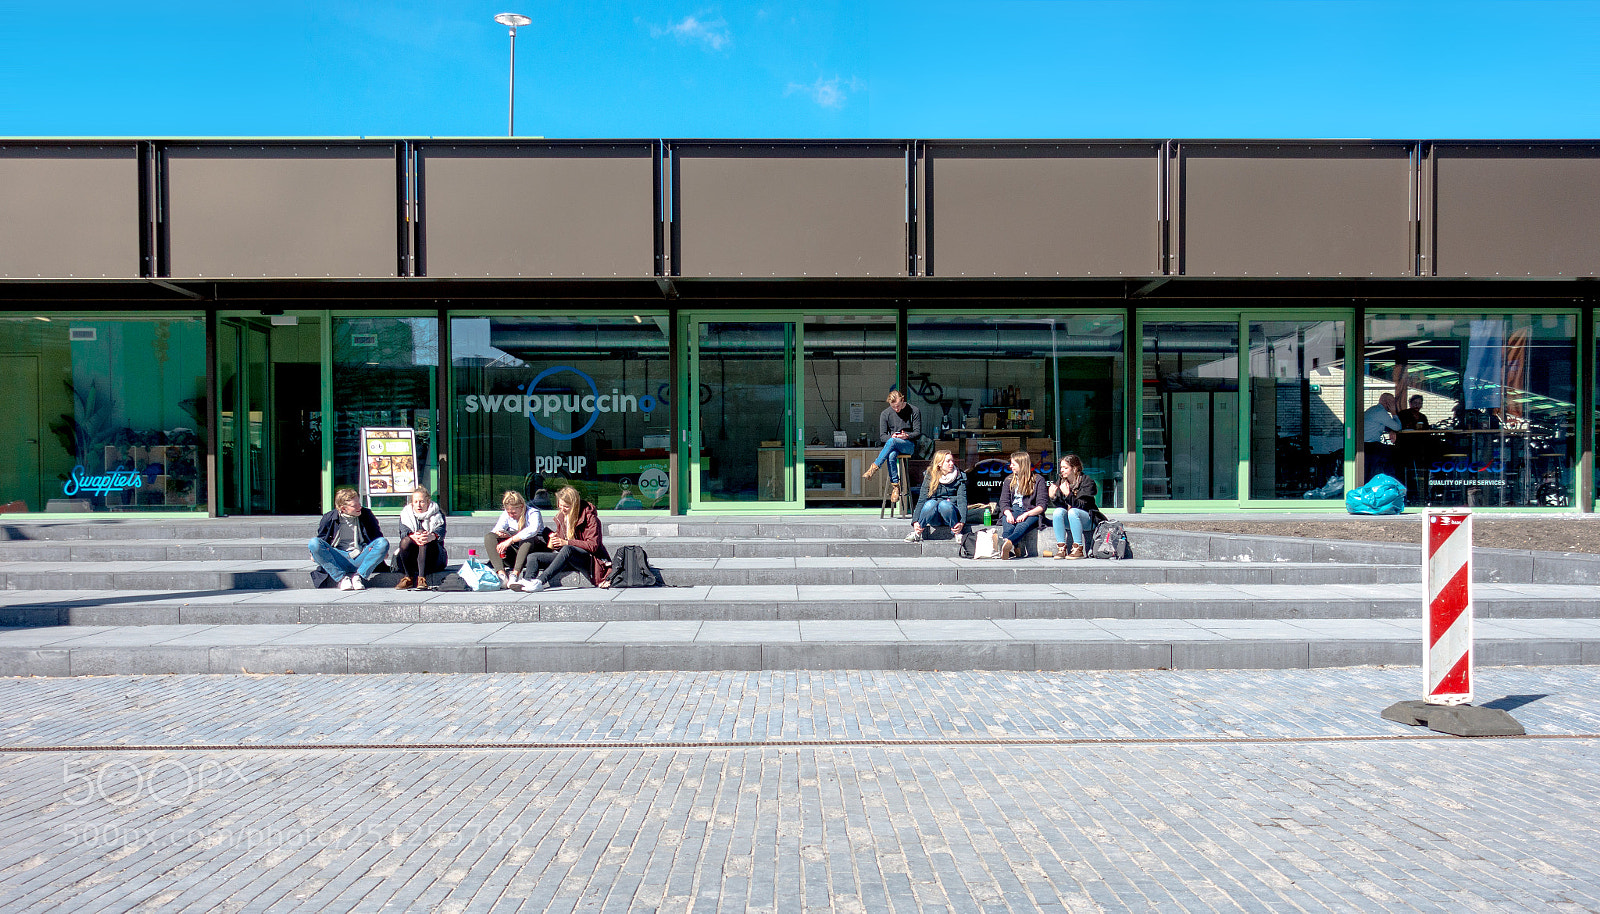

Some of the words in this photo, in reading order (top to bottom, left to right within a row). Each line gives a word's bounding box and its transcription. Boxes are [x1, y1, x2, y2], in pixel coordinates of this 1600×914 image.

[465, 388, 656, 417] swappuccino
[535, 455, 587, 474] POP-UP
[64, 464, 142, 496] Swapfiets
